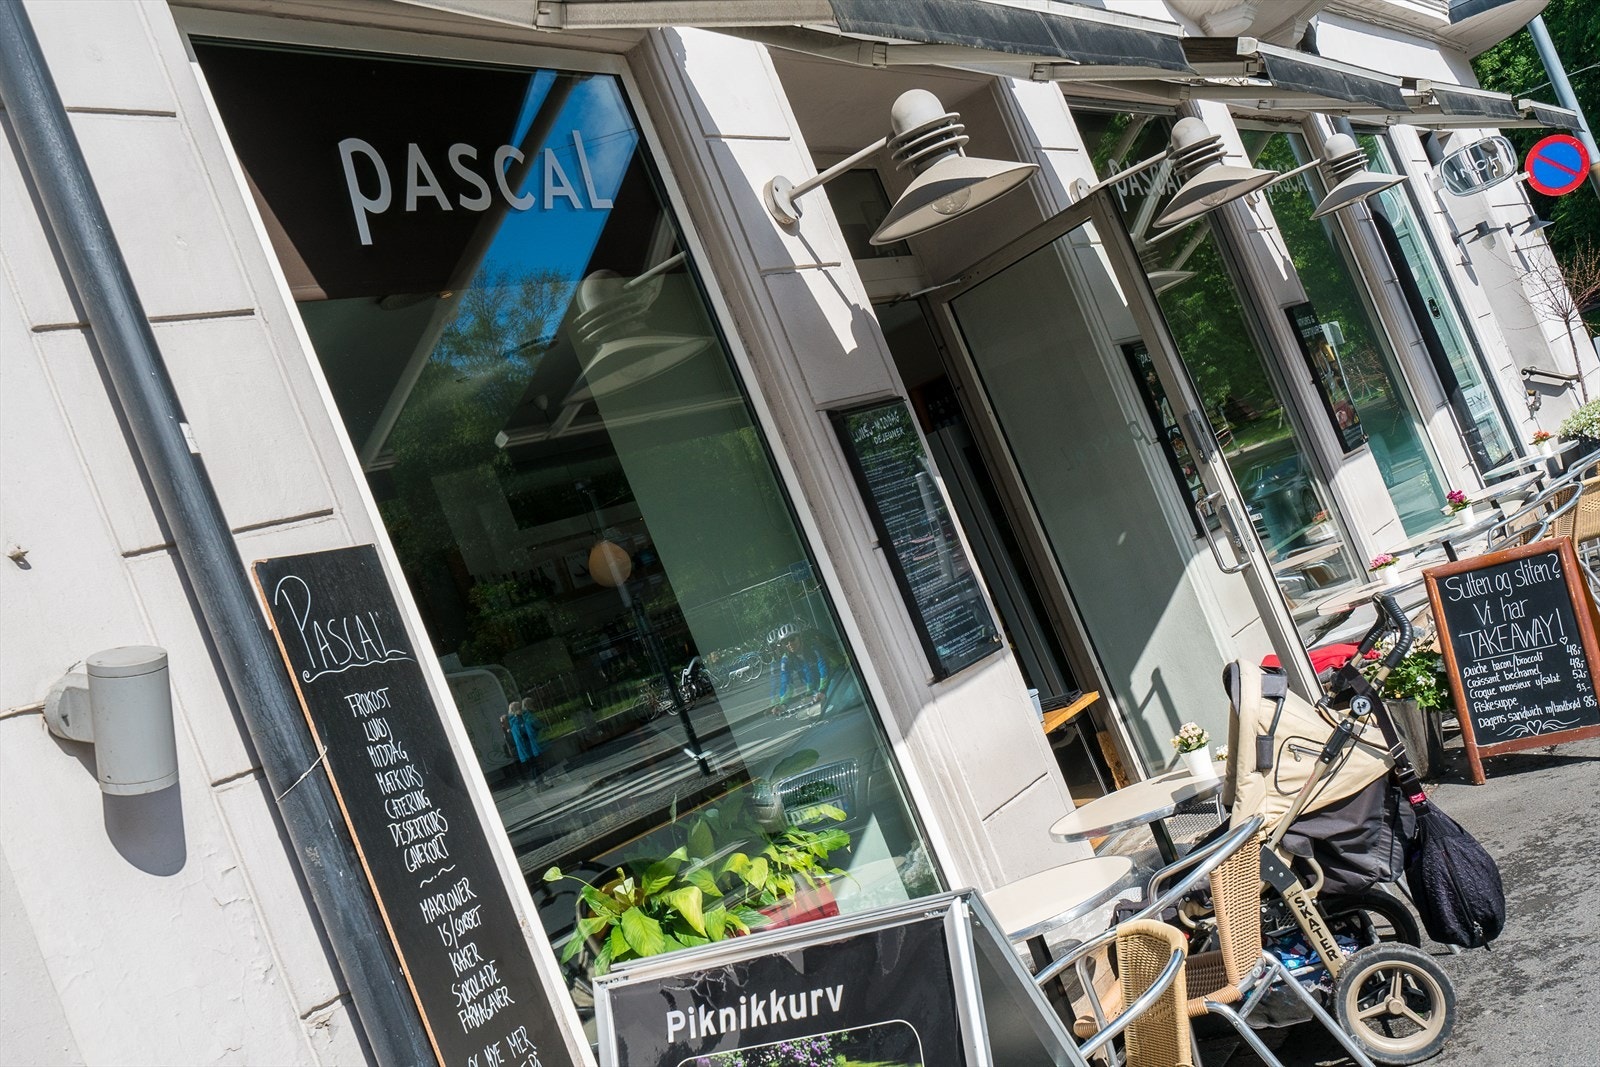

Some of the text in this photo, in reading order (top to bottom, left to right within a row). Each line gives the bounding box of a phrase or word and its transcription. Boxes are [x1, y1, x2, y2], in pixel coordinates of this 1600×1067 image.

[1445, 553, 1561, 602] Sulten og sliten?
[1473, 597, 1528, 626] Vi har
[1458, 608, 1566, 658] TAKEAWAY!
[1463, 663, 1488, 678] Quiche
[1491, 652, 1544, 672] bacon/broccoli
[1467, 673, 1501, 689] Croissant
[1503, 664, 1542, 681] bechamel
[1469, 687, 1497, 700] Croque
[1499, 680, 1531, 693] monsieur
[1535, 673, 1561, 689] u/salat
[1473, 697, 1519, 713] Fiskesuppe
[1478, 713, 1507, 730] Dagens
[1507, 704, 1543, 721] sandwich
[384, 789, 432, 819] CATERING
[387, 808, 449, 848] DESSERTKURS
[419, 877, 477, 924] MAKRONER
[1294, 896, 1339, 962] SKATER
[448, 942, 484, 978] KAKER
[666, 984, 844, 1043] Piknikkurv
[506, 1025, 537, 1058] MER
